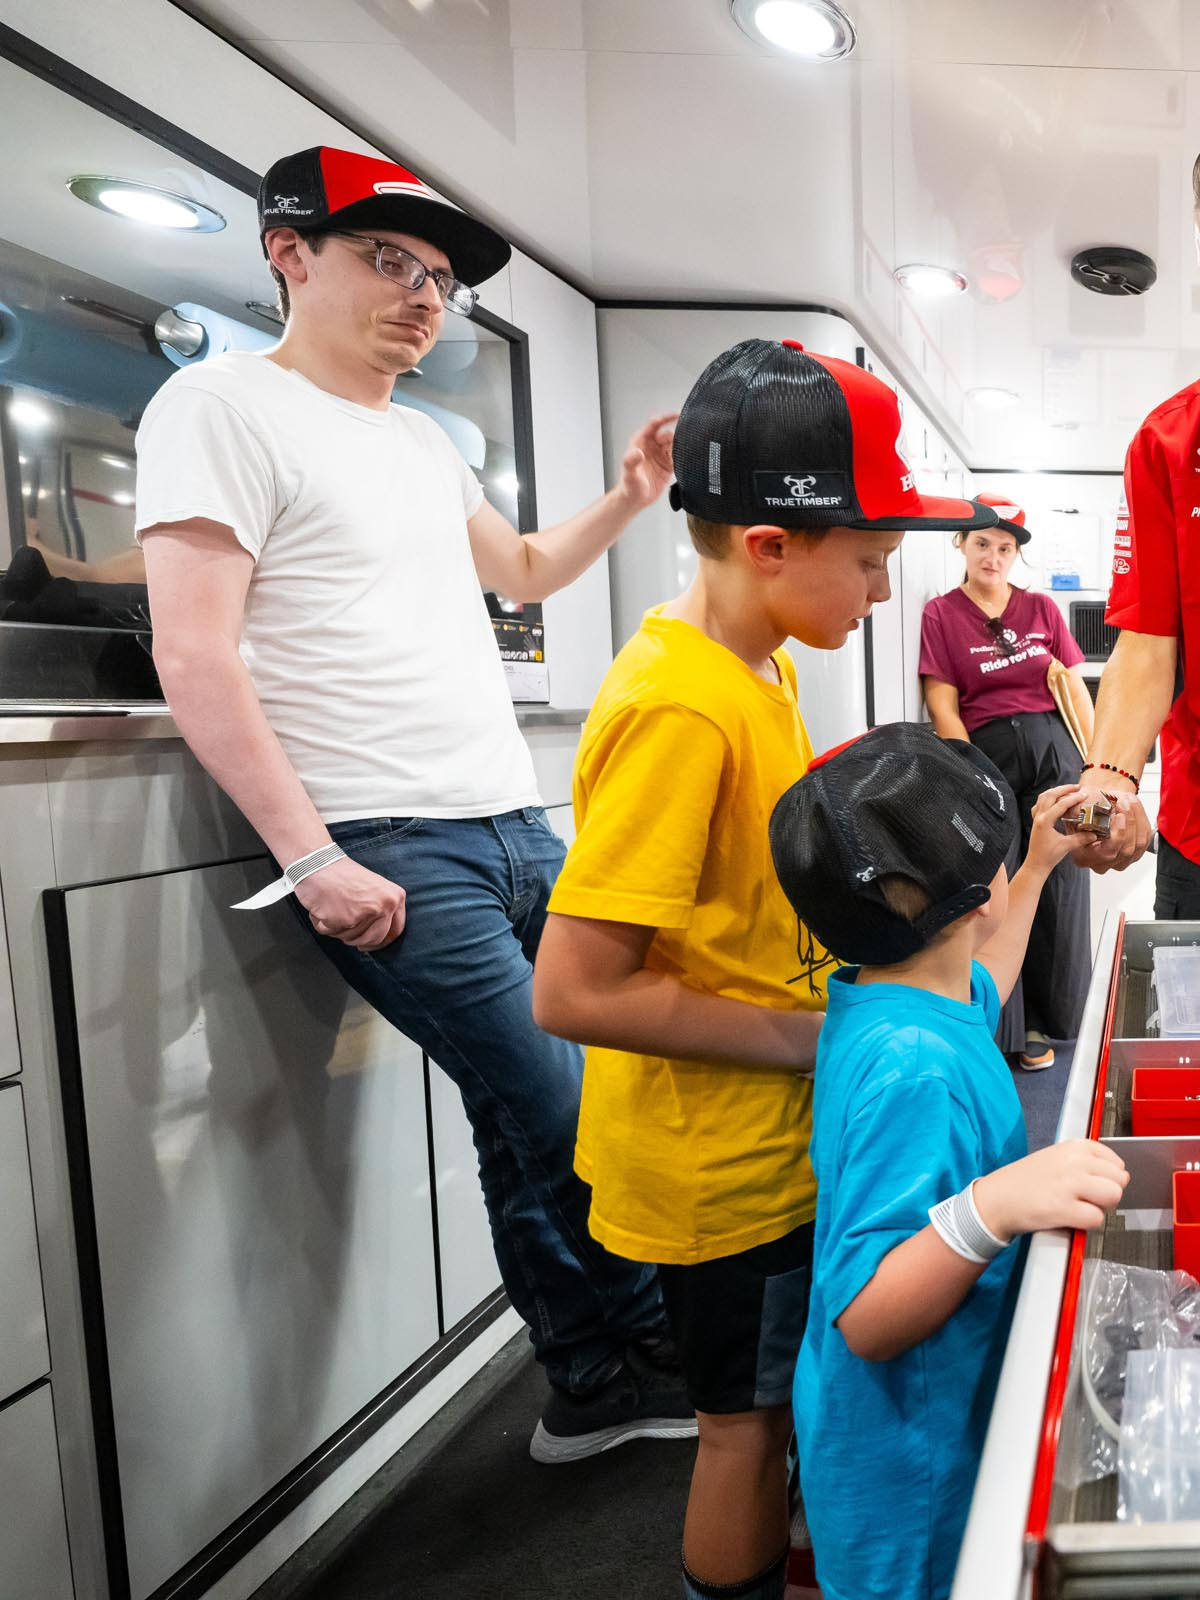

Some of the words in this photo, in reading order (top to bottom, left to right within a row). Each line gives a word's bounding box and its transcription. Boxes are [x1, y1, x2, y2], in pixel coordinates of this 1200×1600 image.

[765, 497, 840, 506] TRUETIMBER
[980, 658, 1009, 674] Ride
[1009, 651, 1027, 664] for
